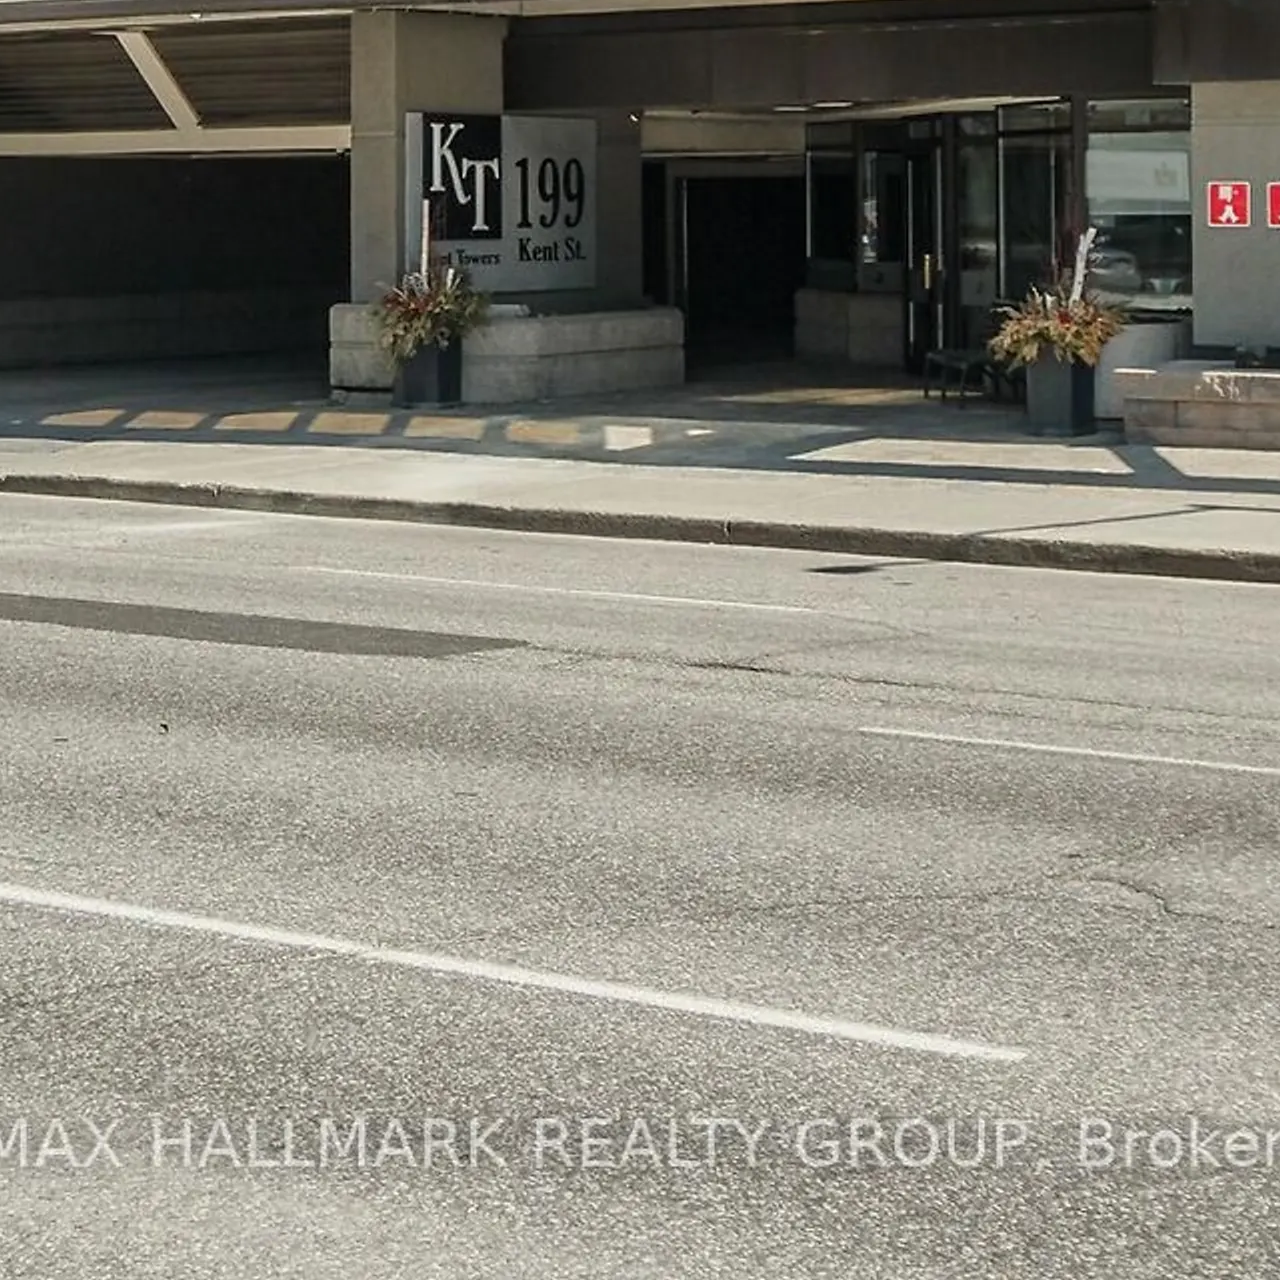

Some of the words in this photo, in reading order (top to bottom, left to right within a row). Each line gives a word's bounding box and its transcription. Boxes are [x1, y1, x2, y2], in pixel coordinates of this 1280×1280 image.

[515, 157, 585, 229] 199
[518, 238, 560, 262] Kent
[564, 237, 587, 261] St.
